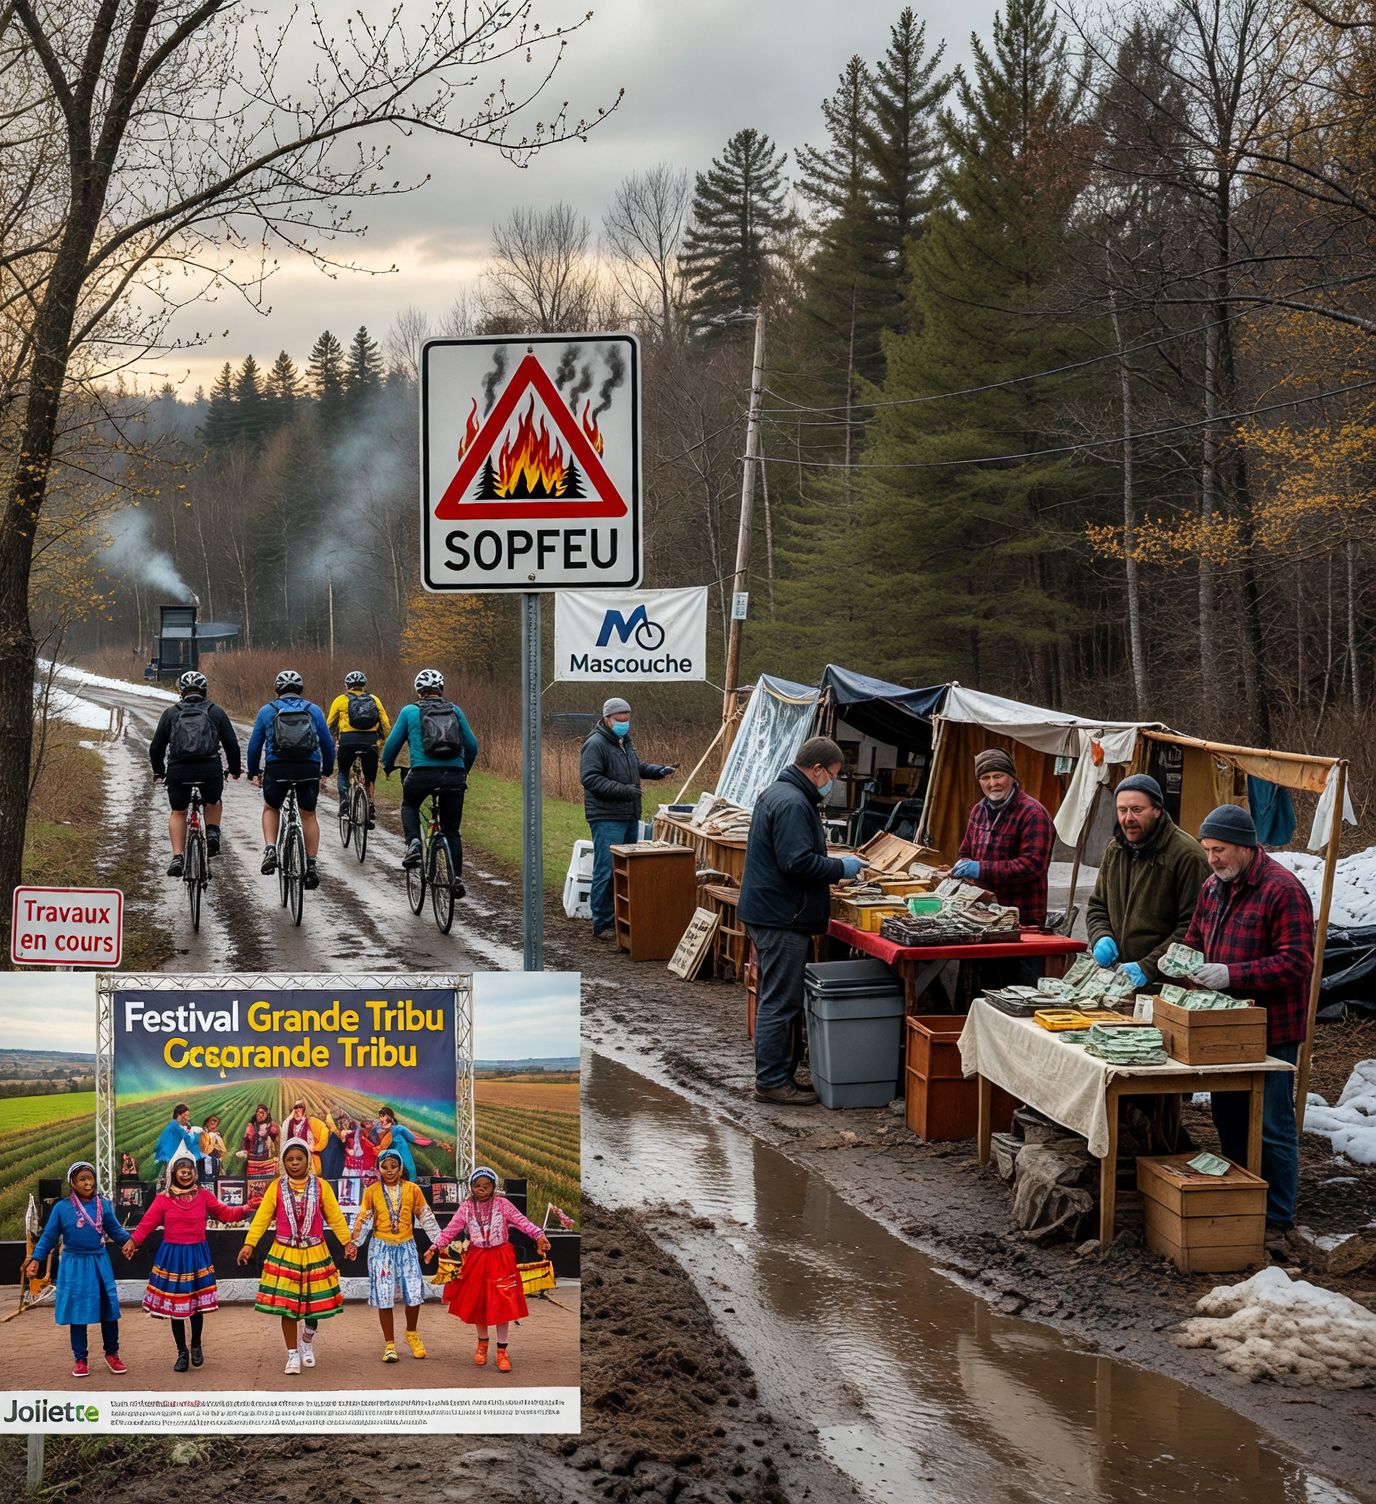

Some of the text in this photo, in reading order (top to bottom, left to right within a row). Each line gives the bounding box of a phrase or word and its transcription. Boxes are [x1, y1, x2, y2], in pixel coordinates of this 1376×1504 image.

[444, 528, 618, 571] SOPFEU
[570, 653, 693, 673] Mascouche
[24, 900, 111, 924] Travaux
[21, 933, 113, 953] en cours
[125, 1000, 445, 1033] Festival Grande Tribu
[337, 1036, 417, 1068] Tribu
